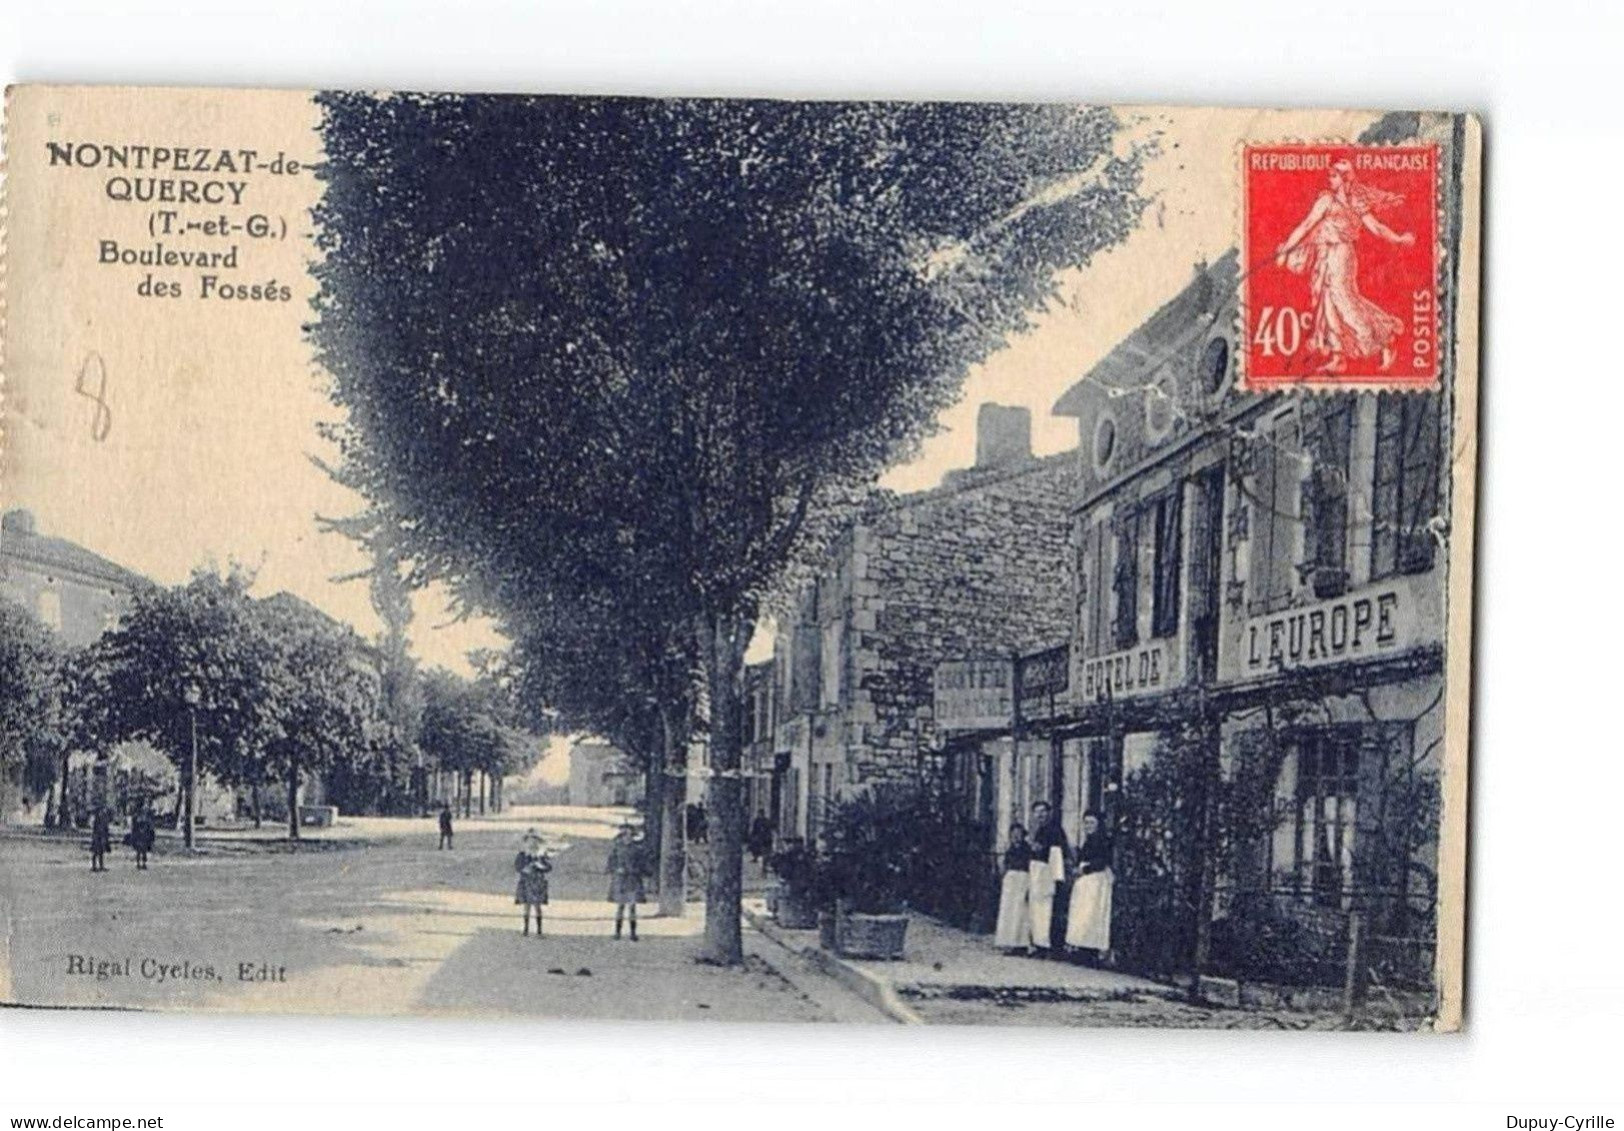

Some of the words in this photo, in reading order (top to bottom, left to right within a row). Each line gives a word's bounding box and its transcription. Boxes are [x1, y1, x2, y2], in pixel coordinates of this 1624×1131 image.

[1356, 153, 1430, 173] FRANÇAISE
[105, 176, 248, 205] QUERCY
[99, 240, 239, 269] Boulevard
[136, 273, 183, 298] des
[200, 275, 292, 302] Fossés
[1412, 289, 1431, 369] POSTES
[1085, 654, 1134, 697] HOTEL
[1138, 647, 1161, 688] DE
[66, 953, 131, 982] Rigal
[237, 961, 288, 983] Edit
